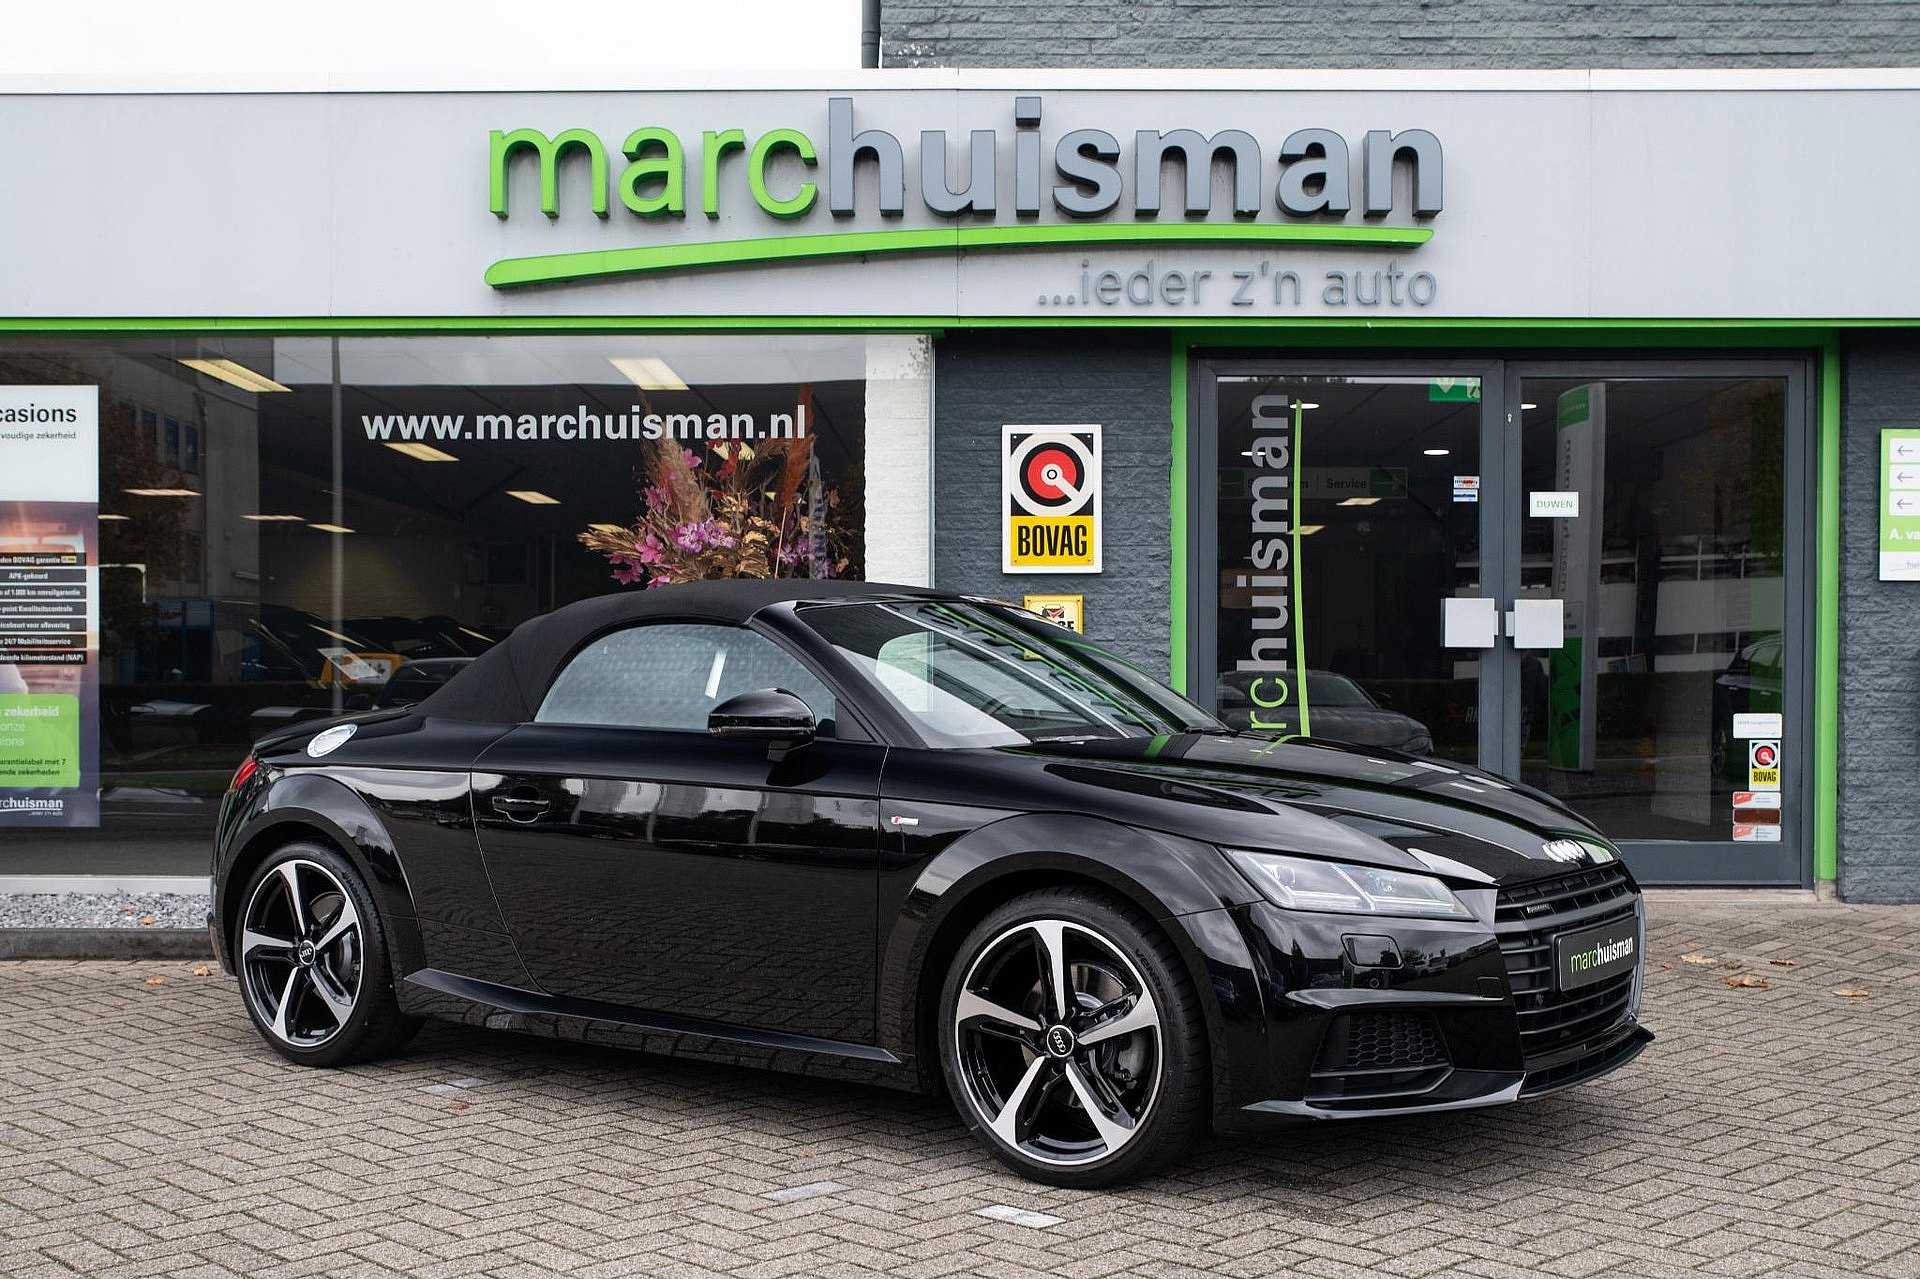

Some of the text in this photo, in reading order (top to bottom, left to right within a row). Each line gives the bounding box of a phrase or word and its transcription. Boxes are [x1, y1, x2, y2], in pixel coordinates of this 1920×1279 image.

[489, 97, 1444, 220] marchuisman
[1038, 259, 1437, 305] ...ieder z'n auto
[361, 405, 806, 440] www.marchuisman.nl
[36, 431, 77, 440] zekerheid
[1326, 477, 1367, 489] Service
[1536, 500, 1573, 509] DUWEN
[1889, 528, 1903, 540] A.
[1017, 524, 1088, 557] BOVAG
[13, 556, 35, 564] BOVAG
[36, 557, 61, 565] garantie
[4, 637, 17, 645] 24/7
[20, 653, 65, 661] kilometerstand
[65, 653, 84, 662] (NAP)
[4, 706, 60, 717] zekerheid
[61, 758, 67, 766] 7
[18, 768, 60, 776] zekerheden
[1753, 771, 1777, 783] BOVAG
[1570, 936, 1634, 973] marchuisman
